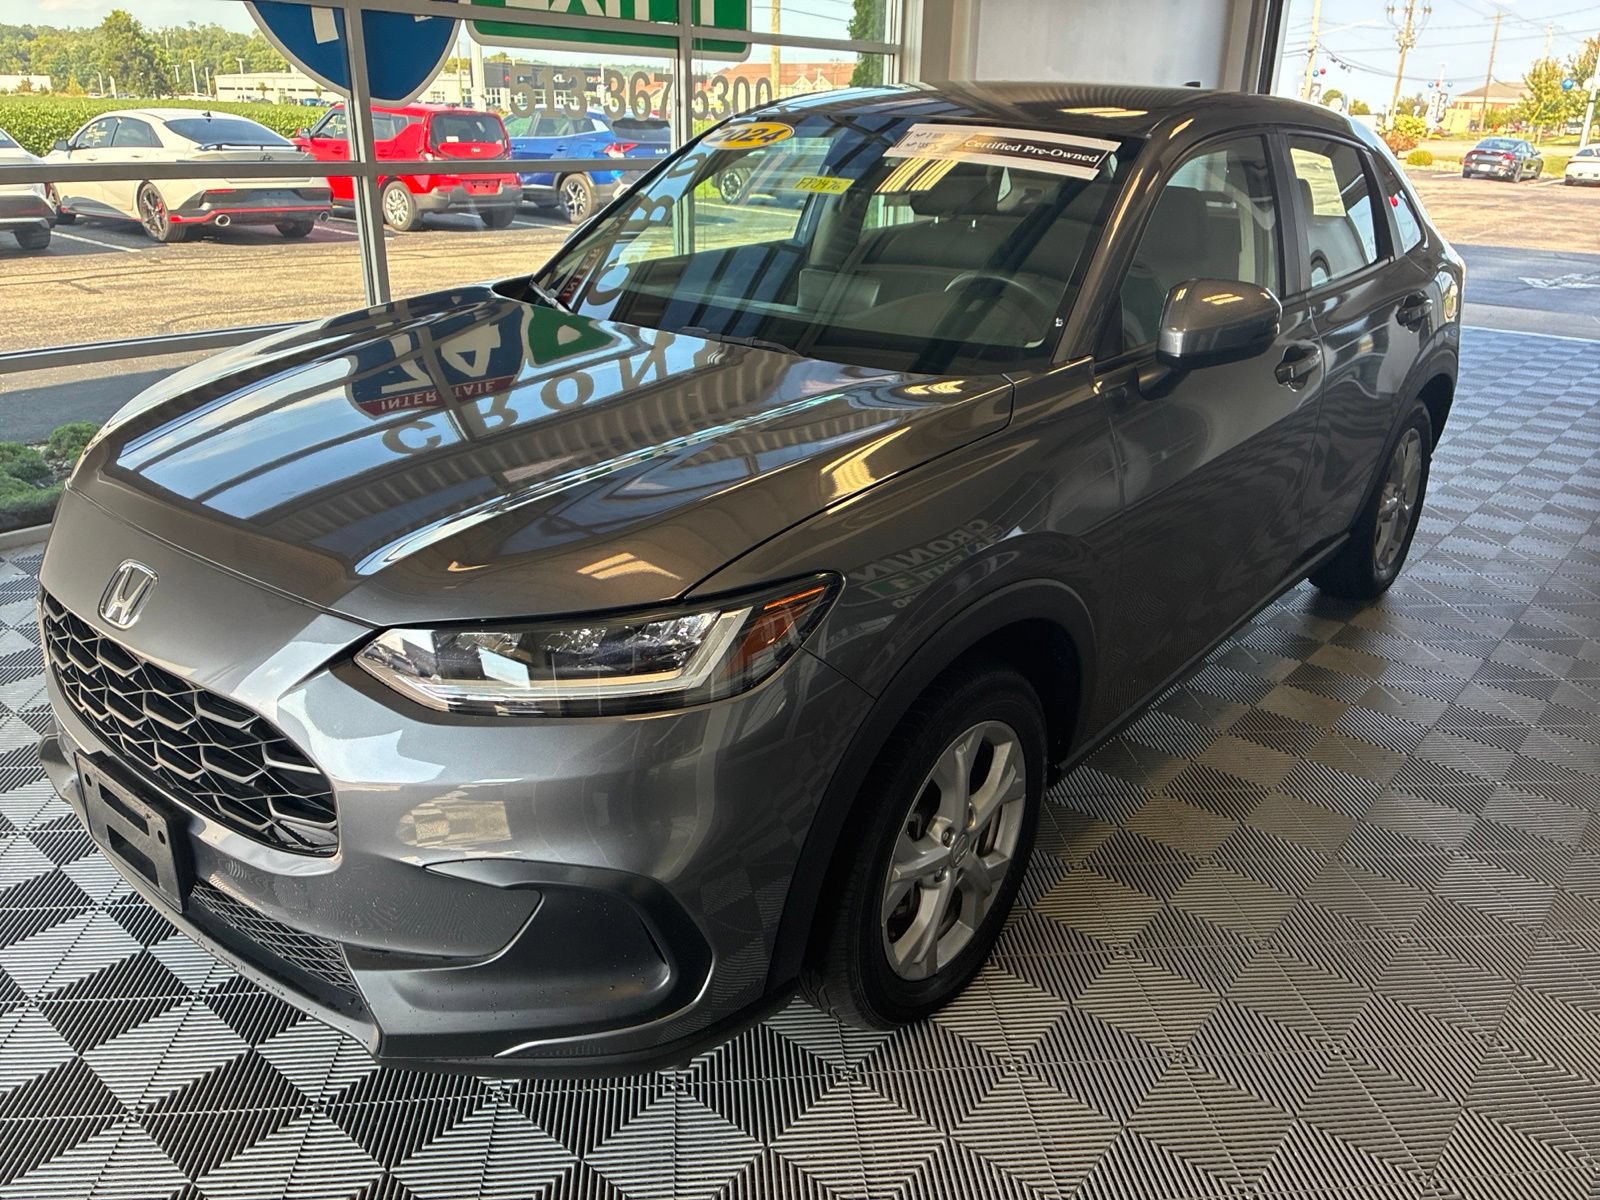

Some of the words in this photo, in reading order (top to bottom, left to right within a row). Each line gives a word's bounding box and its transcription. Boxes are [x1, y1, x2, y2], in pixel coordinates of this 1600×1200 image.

[707, 127, 788, 143] 2024
[964, 139, 1022, 153] Certified
[1023, 145, 1100, 163] Pre-Owned
